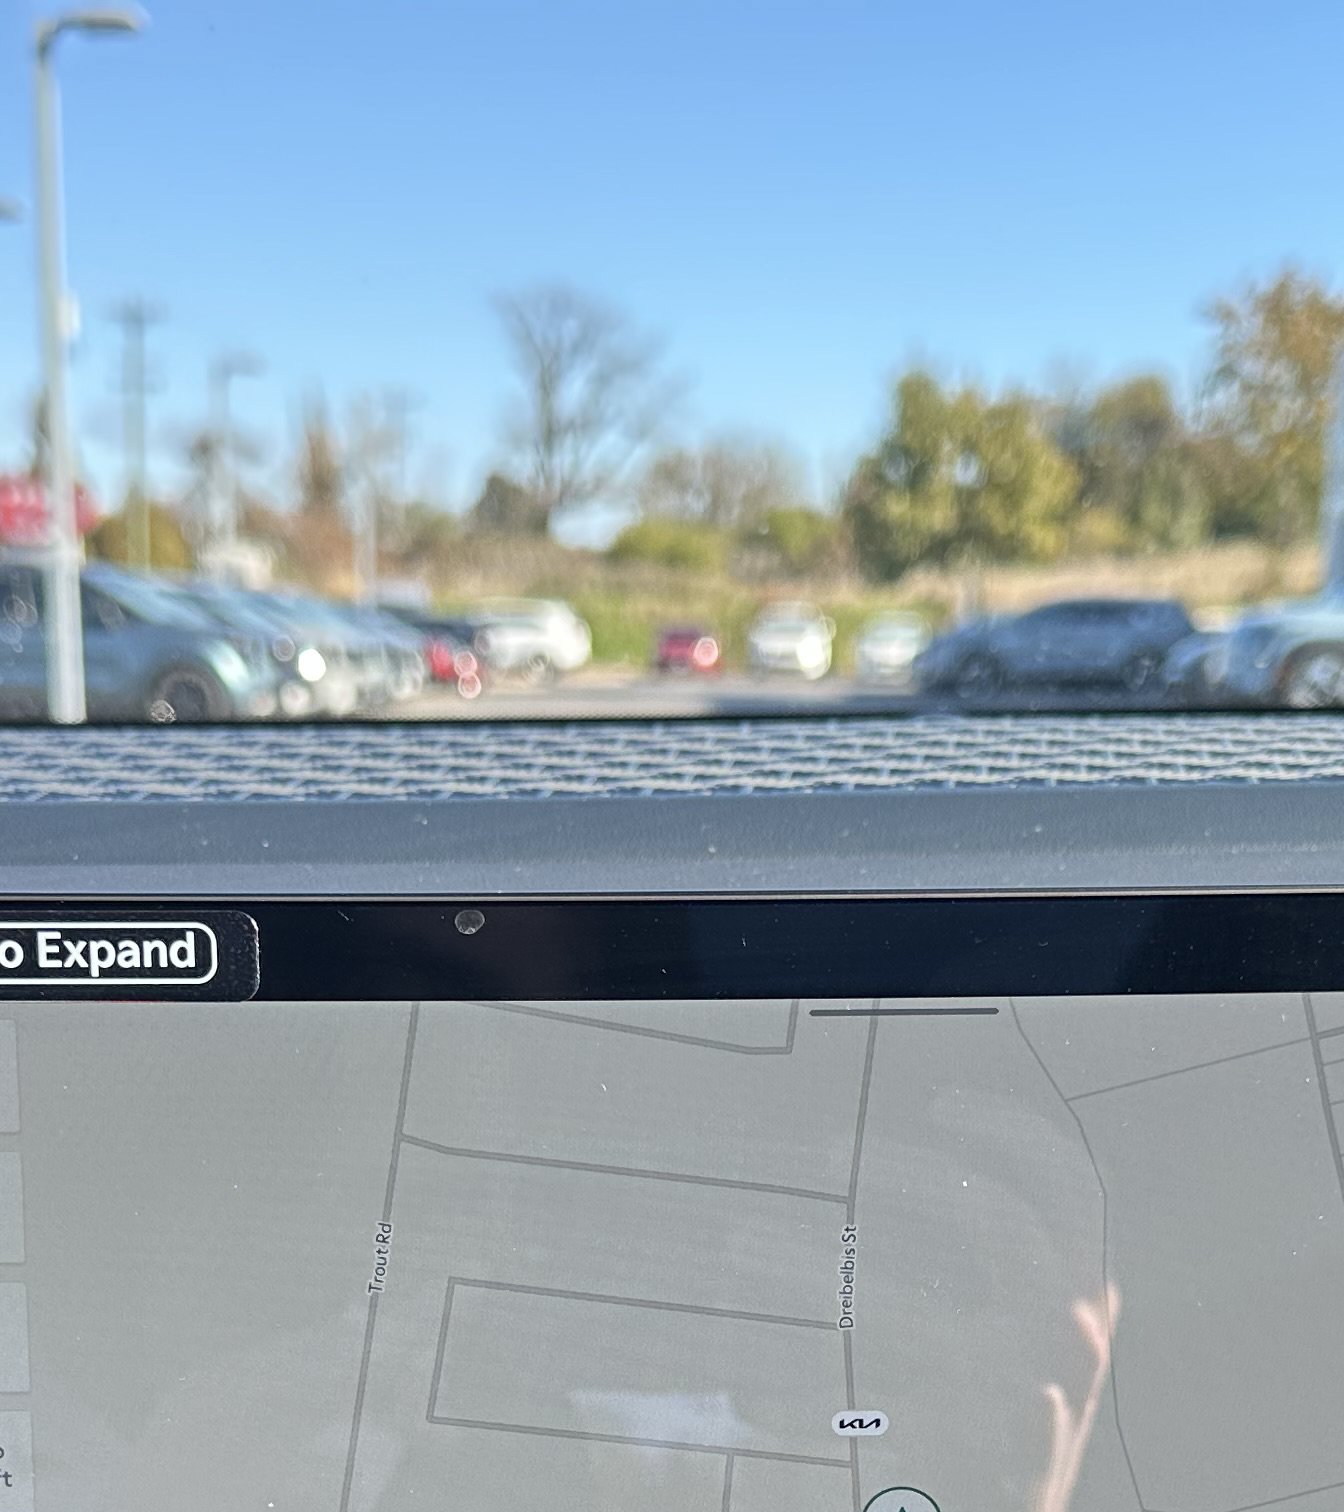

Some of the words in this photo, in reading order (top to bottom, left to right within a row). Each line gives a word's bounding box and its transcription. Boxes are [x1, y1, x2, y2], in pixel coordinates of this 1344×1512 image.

[35, 930, 197, 977] Expand
[376, 1222, 392, 1245] Rd
[841, 1225, 857, 1244] St
[368, 1247, 389, 1294] Trout
[839, 1246, 856, 1329] Dreibelbis
